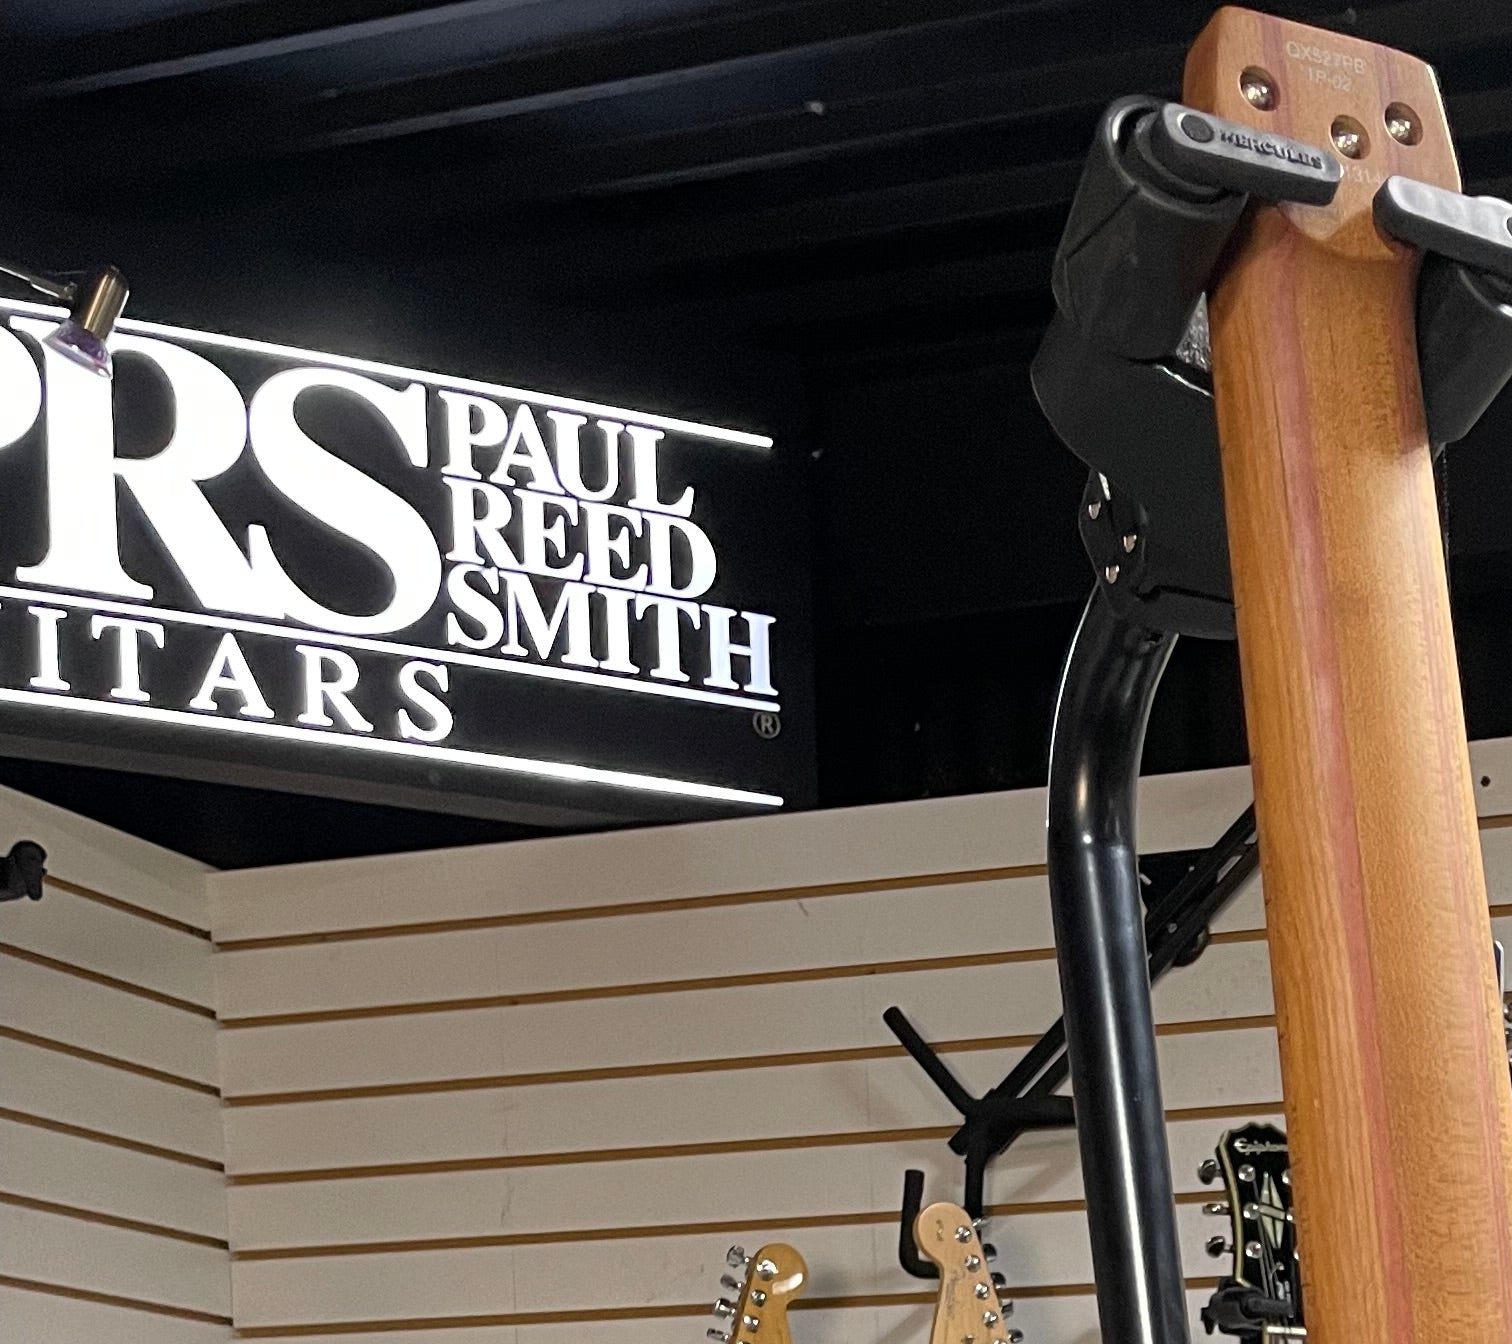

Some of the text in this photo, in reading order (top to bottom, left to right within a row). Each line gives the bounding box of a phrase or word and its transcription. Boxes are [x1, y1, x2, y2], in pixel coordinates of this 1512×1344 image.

[0, 314, 442, 637] RS
[438, 388, 696, 518] PAUL
[441, 476, 718, 600] REED
[28, 605, 455, 744] ITARS
[446, 566, 779, 697] SMITH
